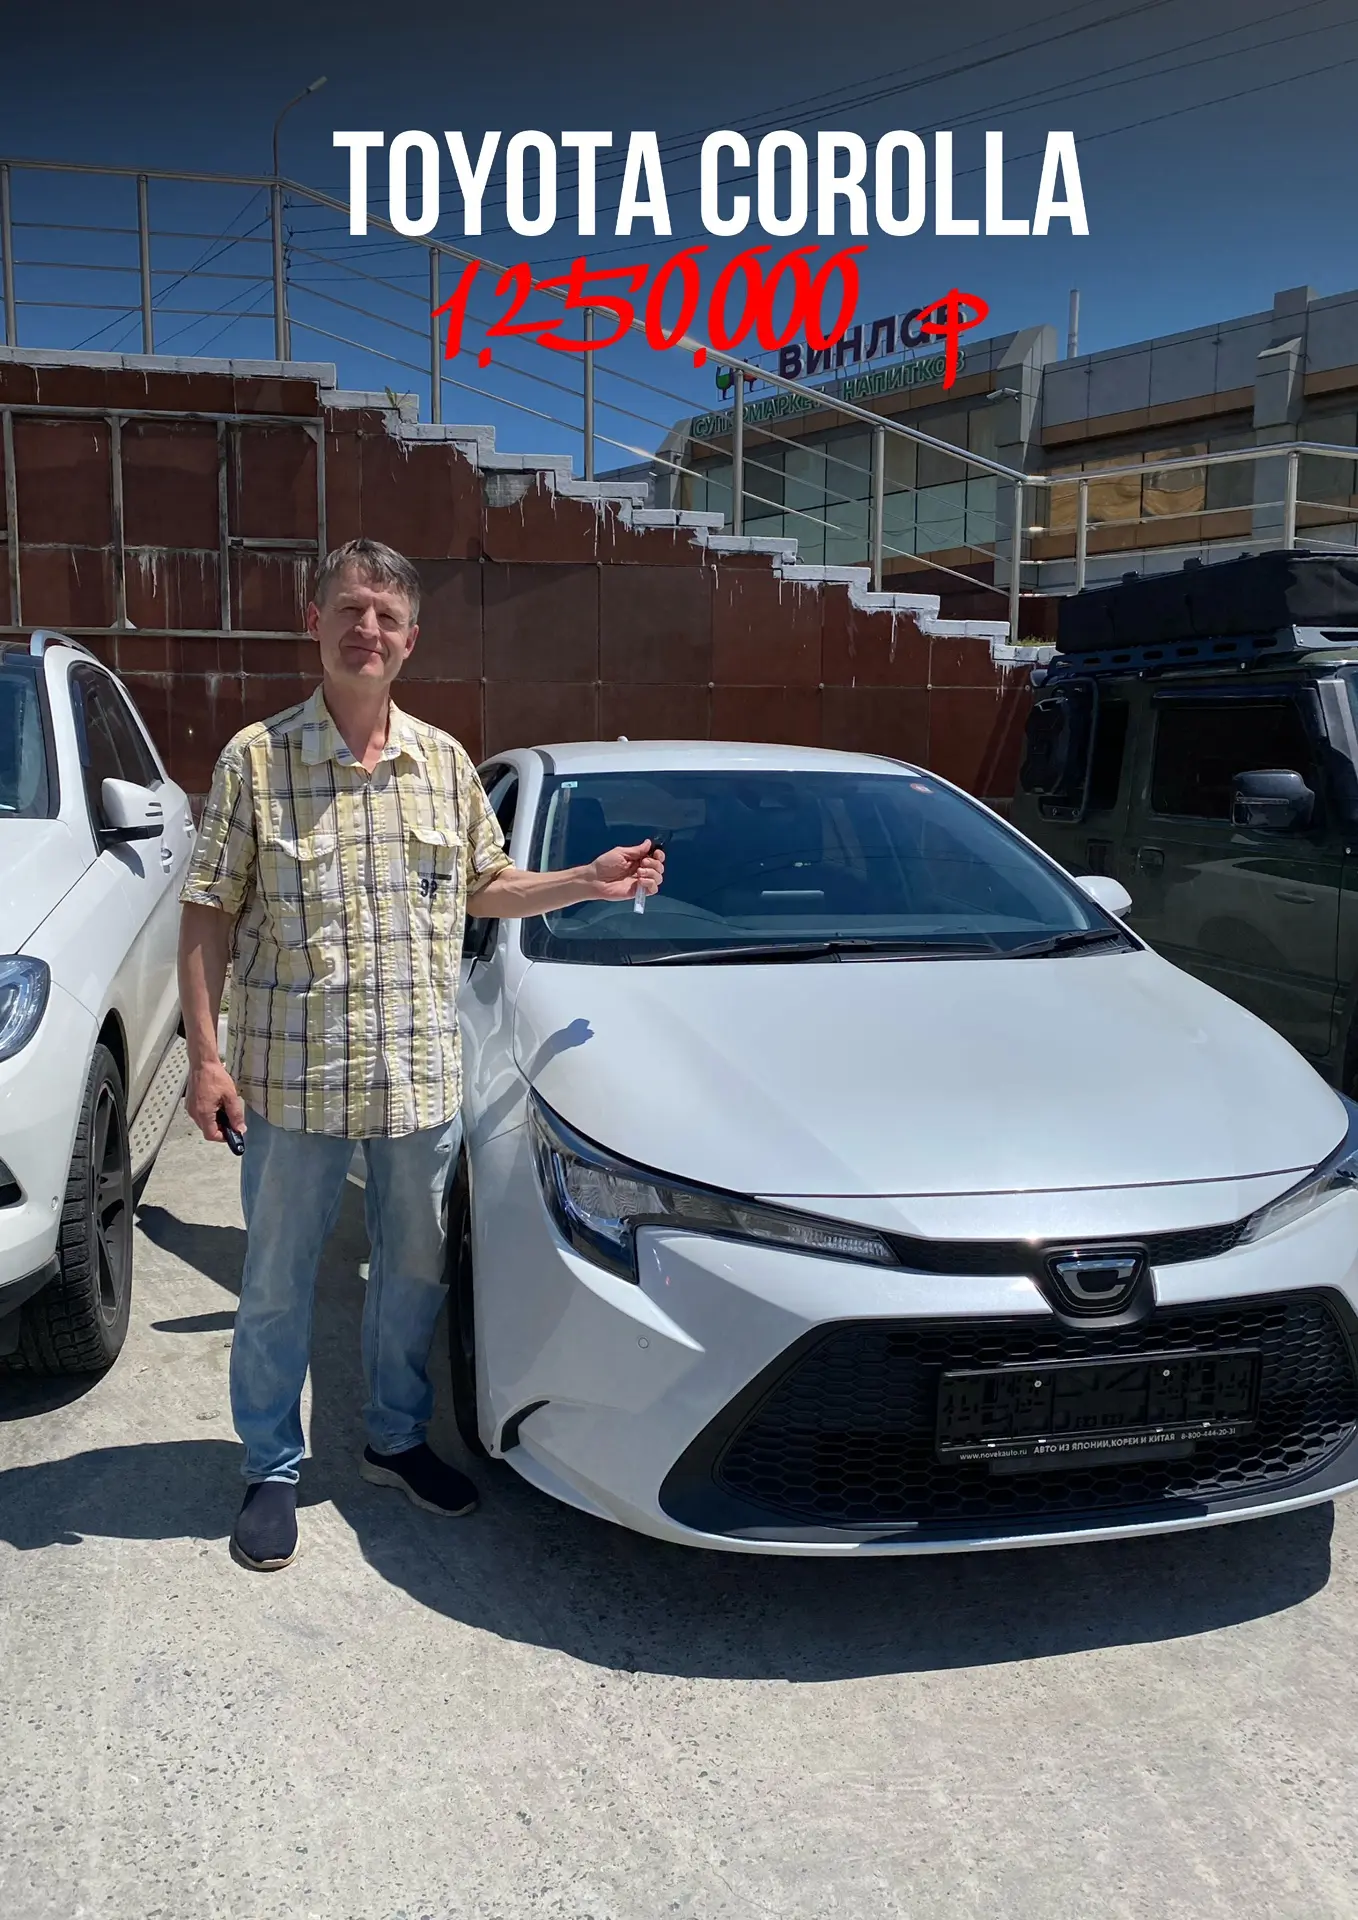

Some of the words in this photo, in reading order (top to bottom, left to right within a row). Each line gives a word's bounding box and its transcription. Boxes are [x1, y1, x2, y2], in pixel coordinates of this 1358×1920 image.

[692, 384, 826, 438] СУПРМАРКЕ
[1033, 1444, 1058, 1455] АВТО
[1058, 1442, 1070, 1452] ИЗ
[1140, 1437, 1147, 1445] И
[1148, 1432, 1176, 1443] КИТАЯ
